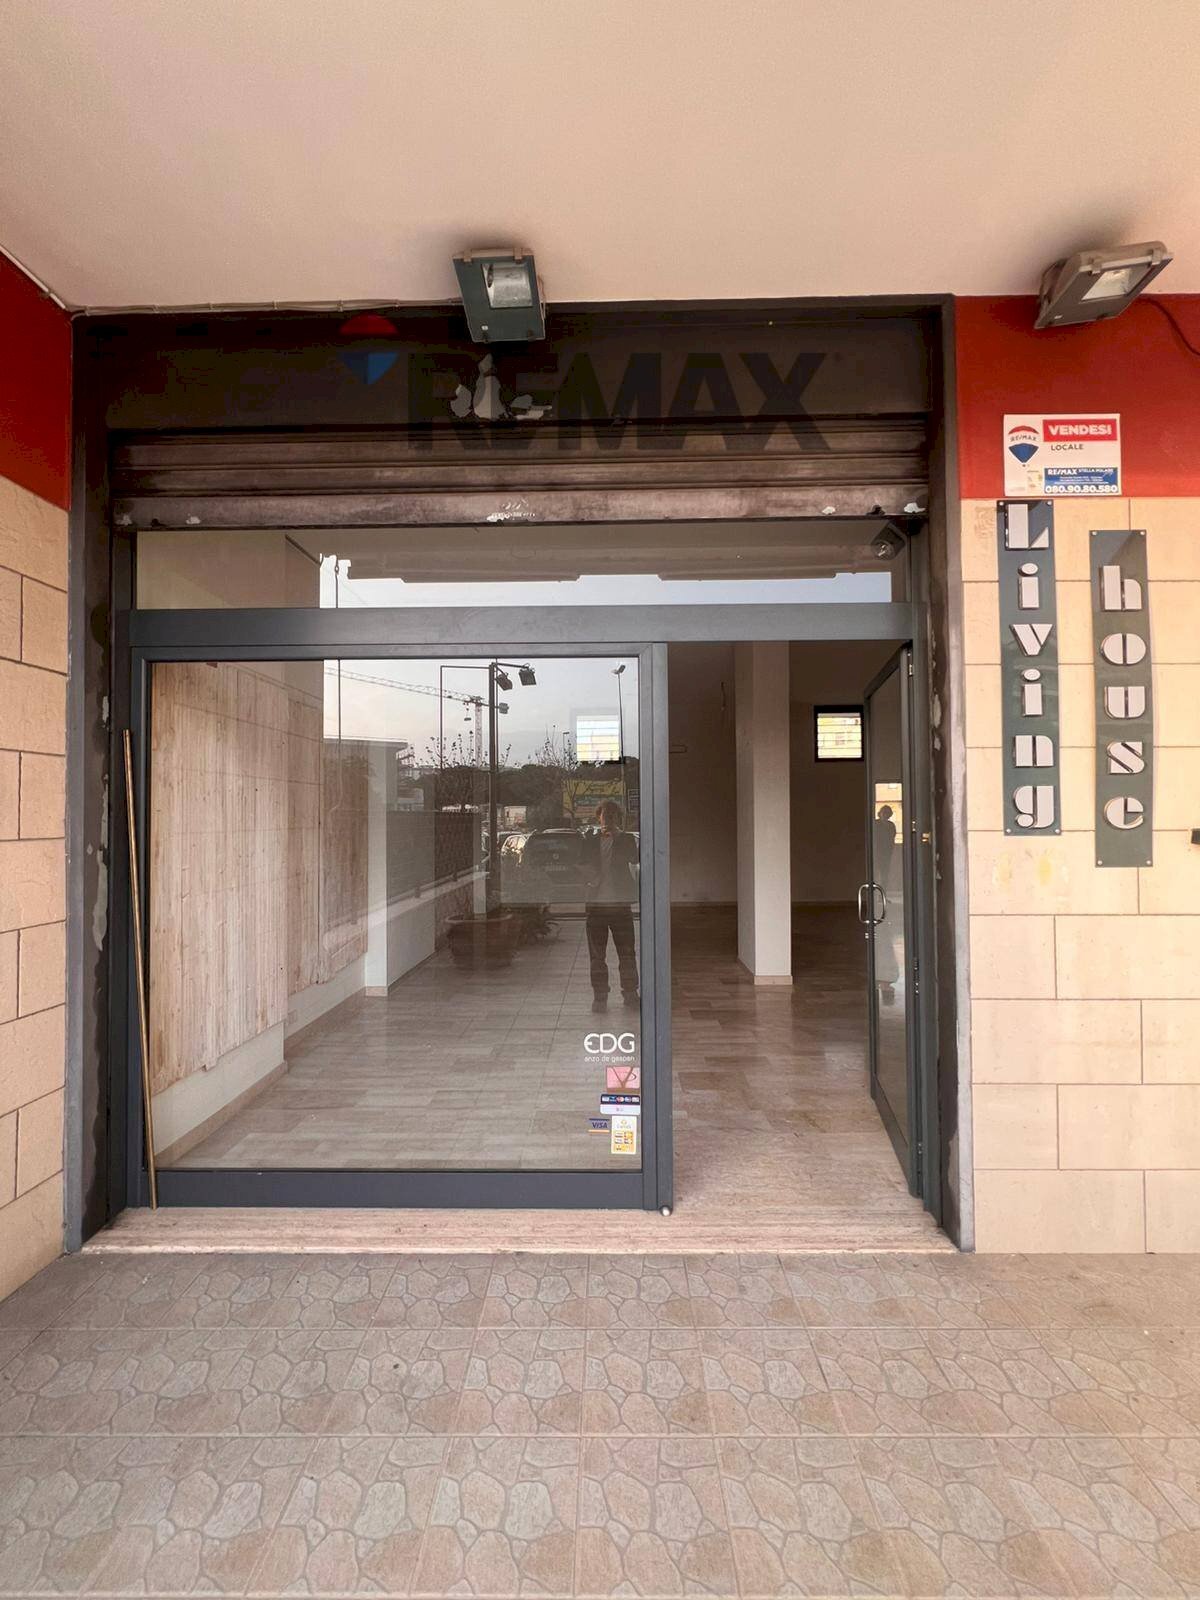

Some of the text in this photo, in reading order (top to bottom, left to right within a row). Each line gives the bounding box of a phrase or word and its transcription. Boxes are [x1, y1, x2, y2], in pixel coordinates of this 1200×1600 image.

[1048, 424, 1112, 435] VENDESI
[1045, 485, 1118, 493] 080.90.80.580
[1005, 504, 1054, 828] Living
[1101, 565, 1147, 830] house
[584, 1033, 635, 1053] EDG
